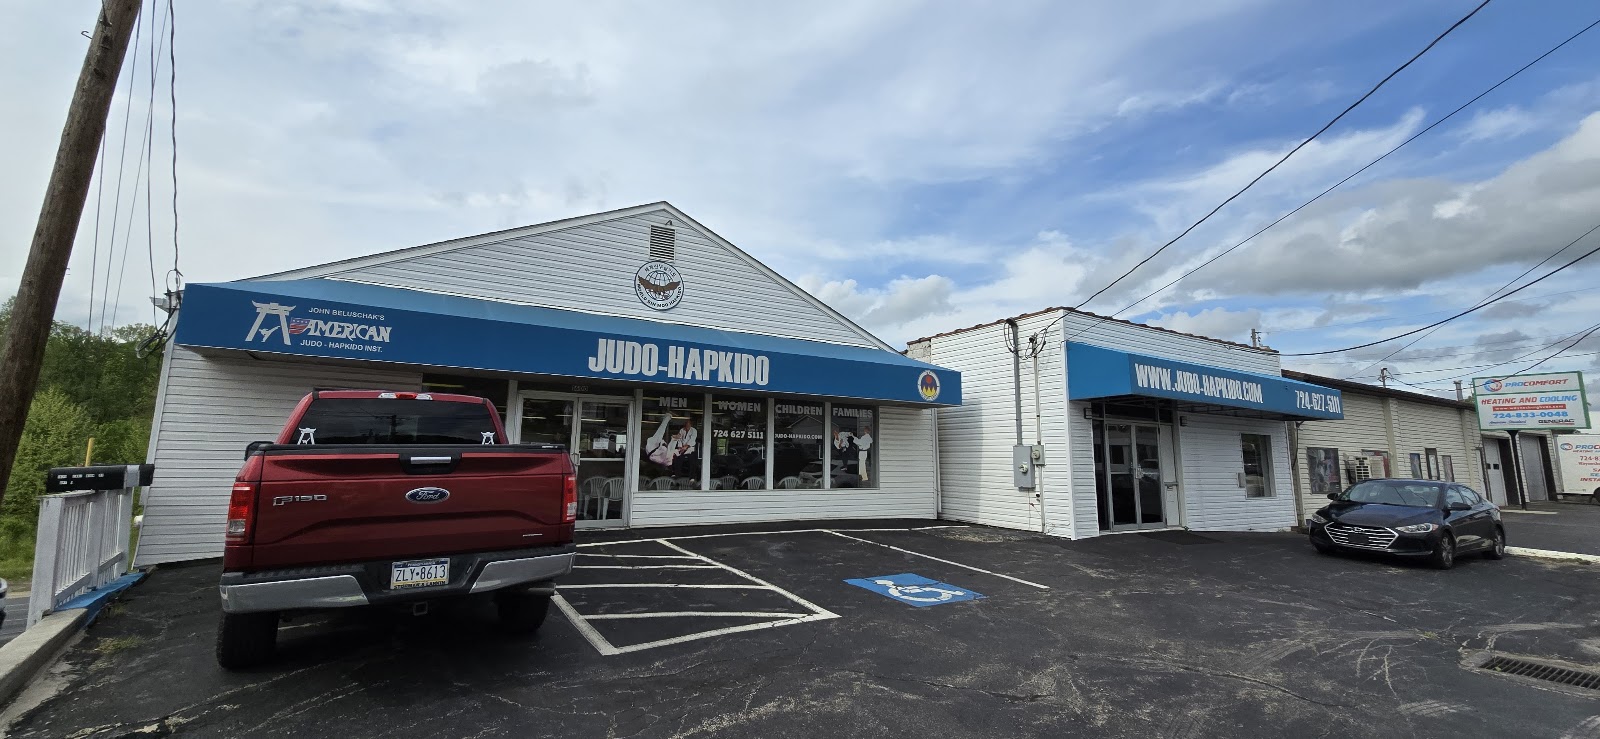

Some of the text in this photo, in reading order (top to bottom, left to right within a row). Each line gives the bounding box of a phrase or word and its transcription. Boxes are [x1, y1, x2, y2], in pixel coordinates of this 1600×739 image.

[308, 307, 385, 321] JOHN BELUSCHAK'S
[300, 319, 392, 342] AMERICAN
[300, 339, 323, 348] JUDO
[328, 341, 364, 351] HAPKIDO
[365, 345, 383, 353] INST.
[588, 338, 770, 386] JUDO-HAPKIDO
[1134, 363, 1264, 404] WWW.JUDO-HAPKIDO.COM
[1504, 379, 1569, 387] PROCOMFORT
[659, 396, 688, 408] MEN
[718, 401, 761, 413] WOMEN
[1295, 389, 1341, 414] 724-627-5111
[774, 404, 823, 416] CHILDREN
[832, 407, 873, 418] FAMILIES
[713, 429, 764, 440] 724 627 5111
